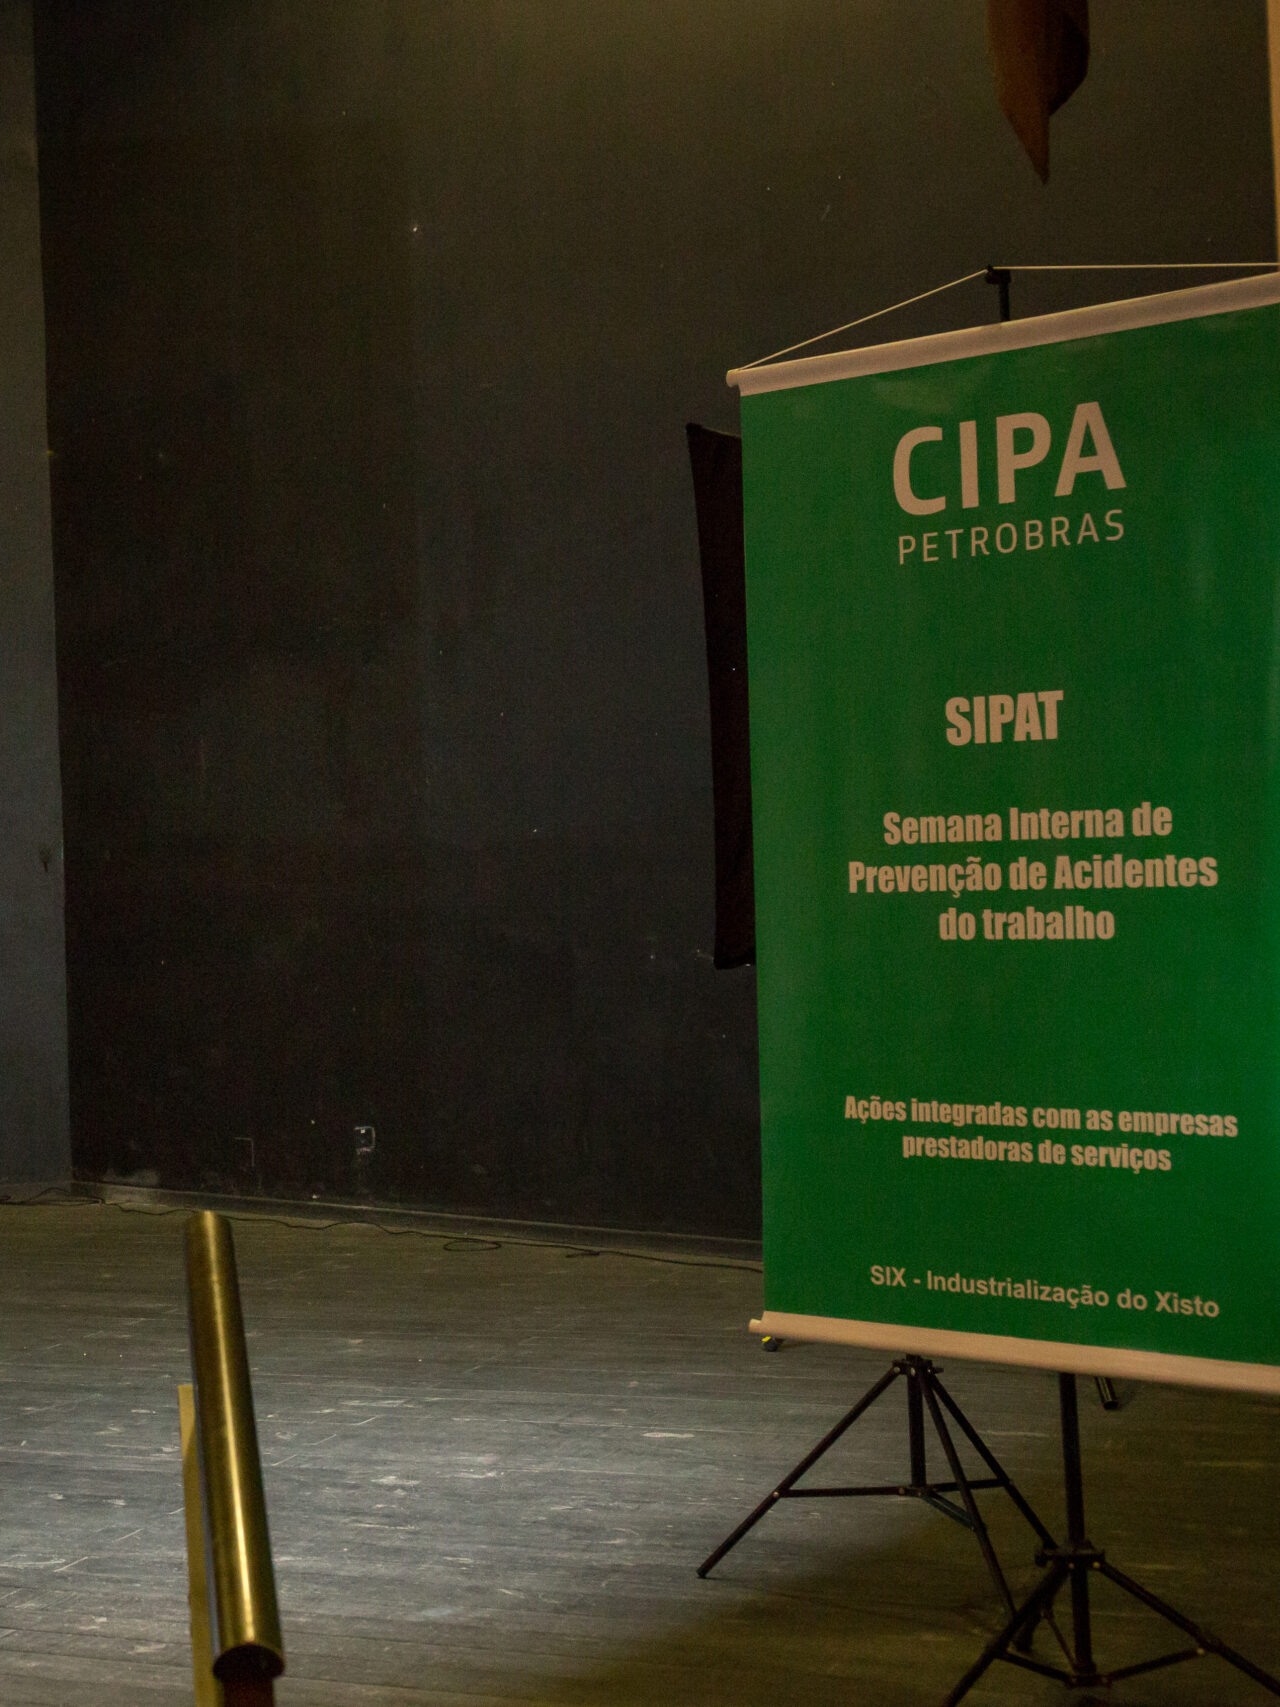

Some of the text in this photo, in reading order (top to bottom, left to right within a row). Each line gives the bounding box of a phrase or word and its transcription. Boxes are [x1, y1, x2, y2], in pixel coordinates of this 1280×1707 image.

[892, 400, 1127, 517] CIPA
[897, 508, 1125, 566] PETROBRAS
[944, 689, 1065, 747] SIPAT
[882, 801, 1173, 846] Semana Interna de
[847, 853, 1219, 899] Prevenção de Acidentes
[938, 905, 1116, 942] do trabalho
[843, 1094, 1239, 1138] Ações integradas com as empresas
[901, 1135, 1173, 1174] prestadoras de serviços
[870, 1264, 907, 1288] SIX
[926, 1269, 1110, 1310] Industrialização
[1116, 1287, 1148, 1311] do
[1154, 1290, 1220, 1318] Xisto
